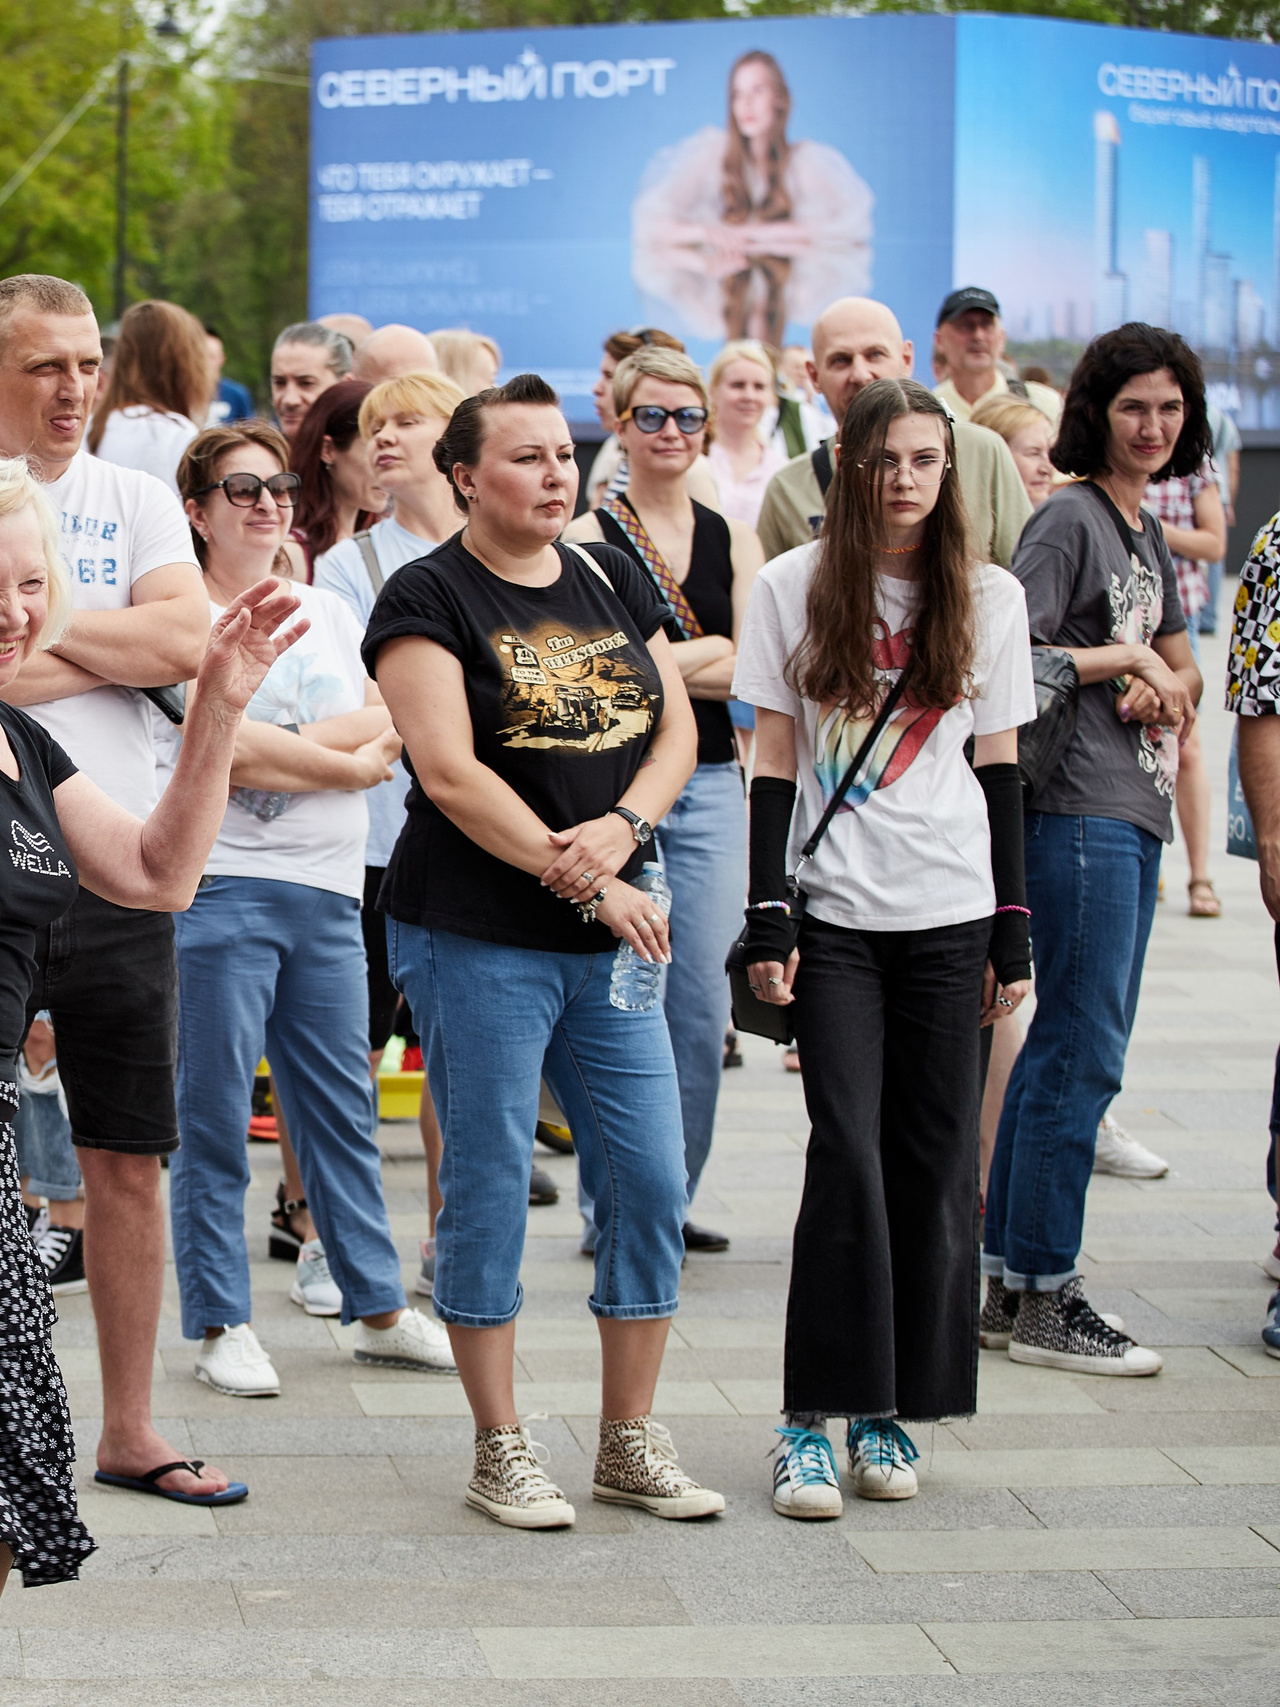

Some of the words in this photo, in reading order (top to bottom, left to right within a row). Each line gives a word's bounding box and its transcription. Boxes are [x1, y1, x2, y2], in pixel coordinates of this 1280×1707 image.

[318, 45, 548, 108] СЕВЕРНЫЙ
[551, 57, 677, 100] ПОРТ
[1097, 60, 1246, 108] СЕВЕРНЫЙ
[543, 632, 628, 668] TELESCOPES
[8, 849, 72, 878] WELLA
